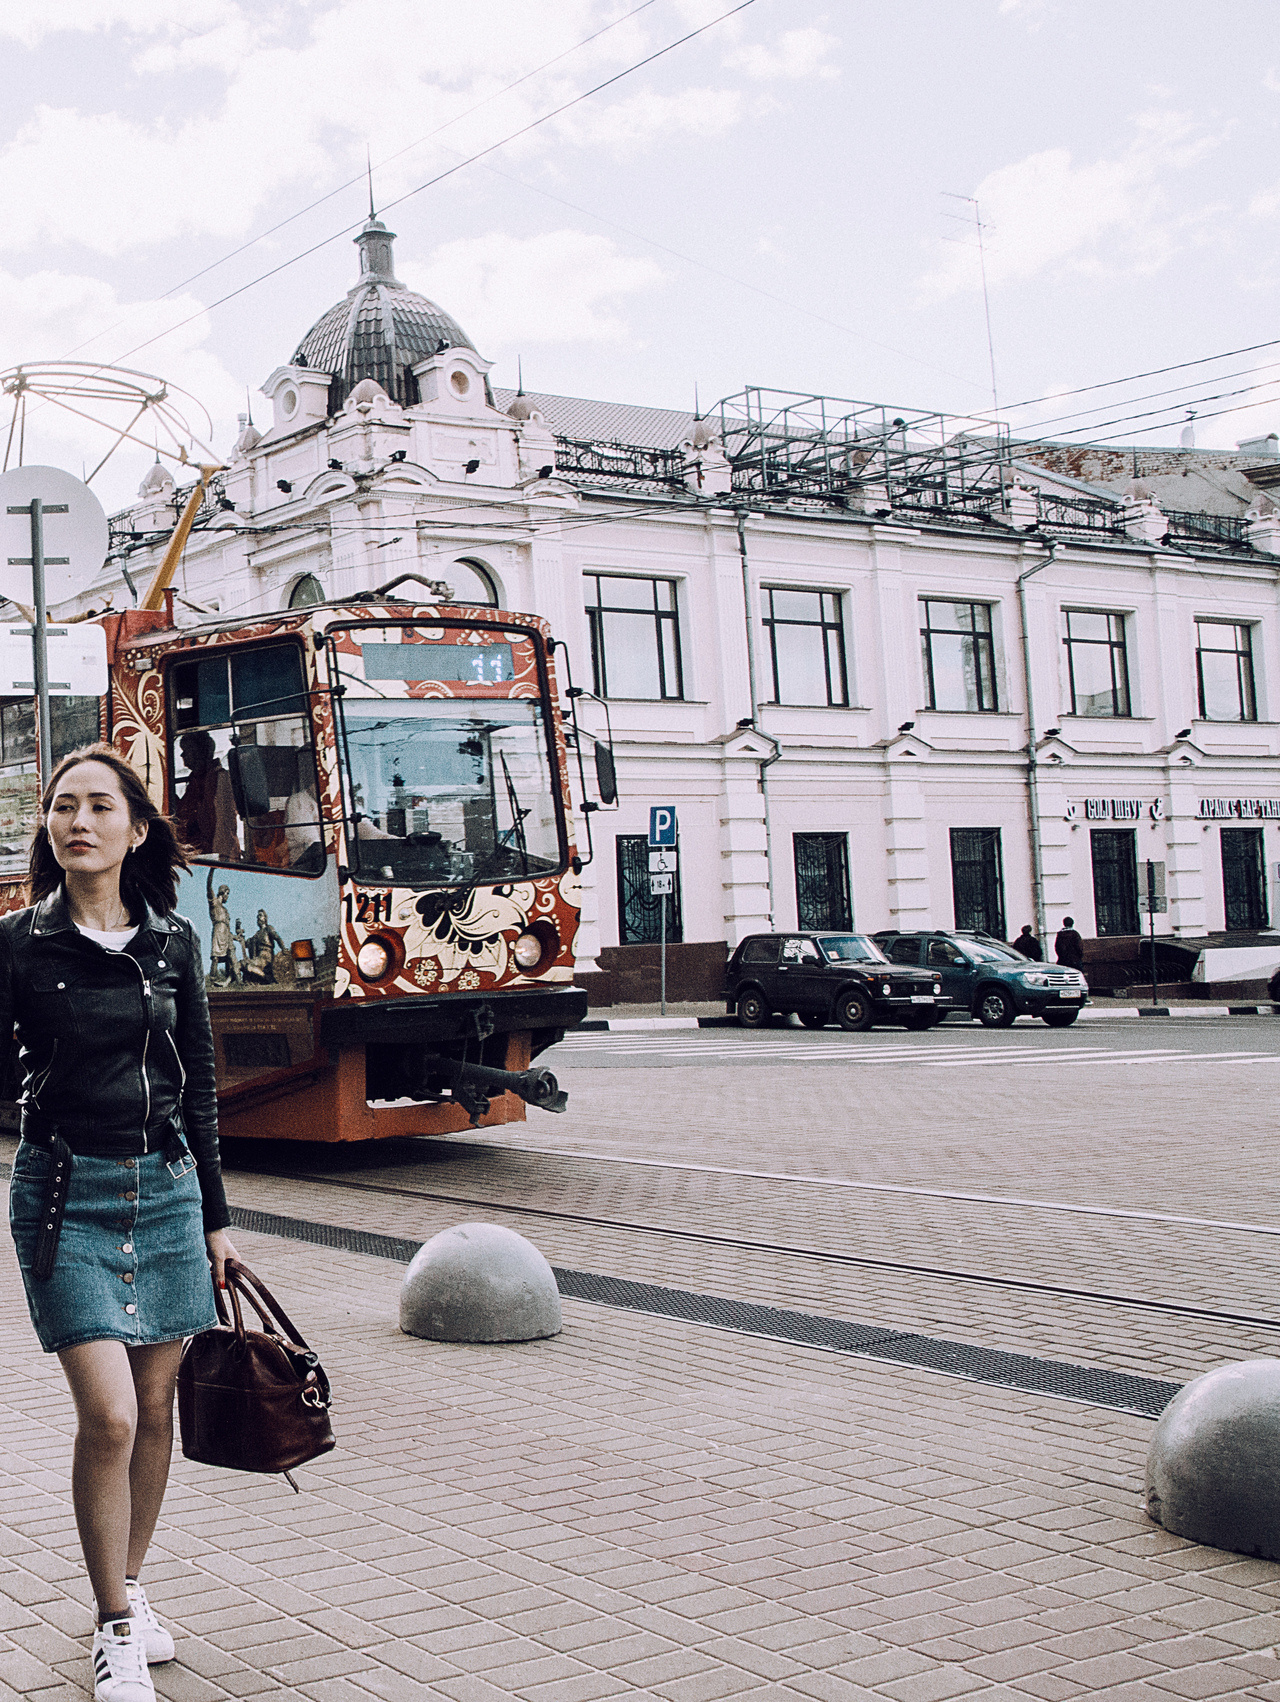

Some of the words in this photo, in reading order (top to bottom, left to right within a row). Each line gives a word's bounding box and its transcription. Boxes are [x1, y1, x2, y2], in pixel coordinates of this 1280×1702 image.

[472, 653, 502, 682] 11
[1086, 798, 1111, 820] GOLD
[655, 809, 672, 842] P
[343, 893, 392, 923] 1211
